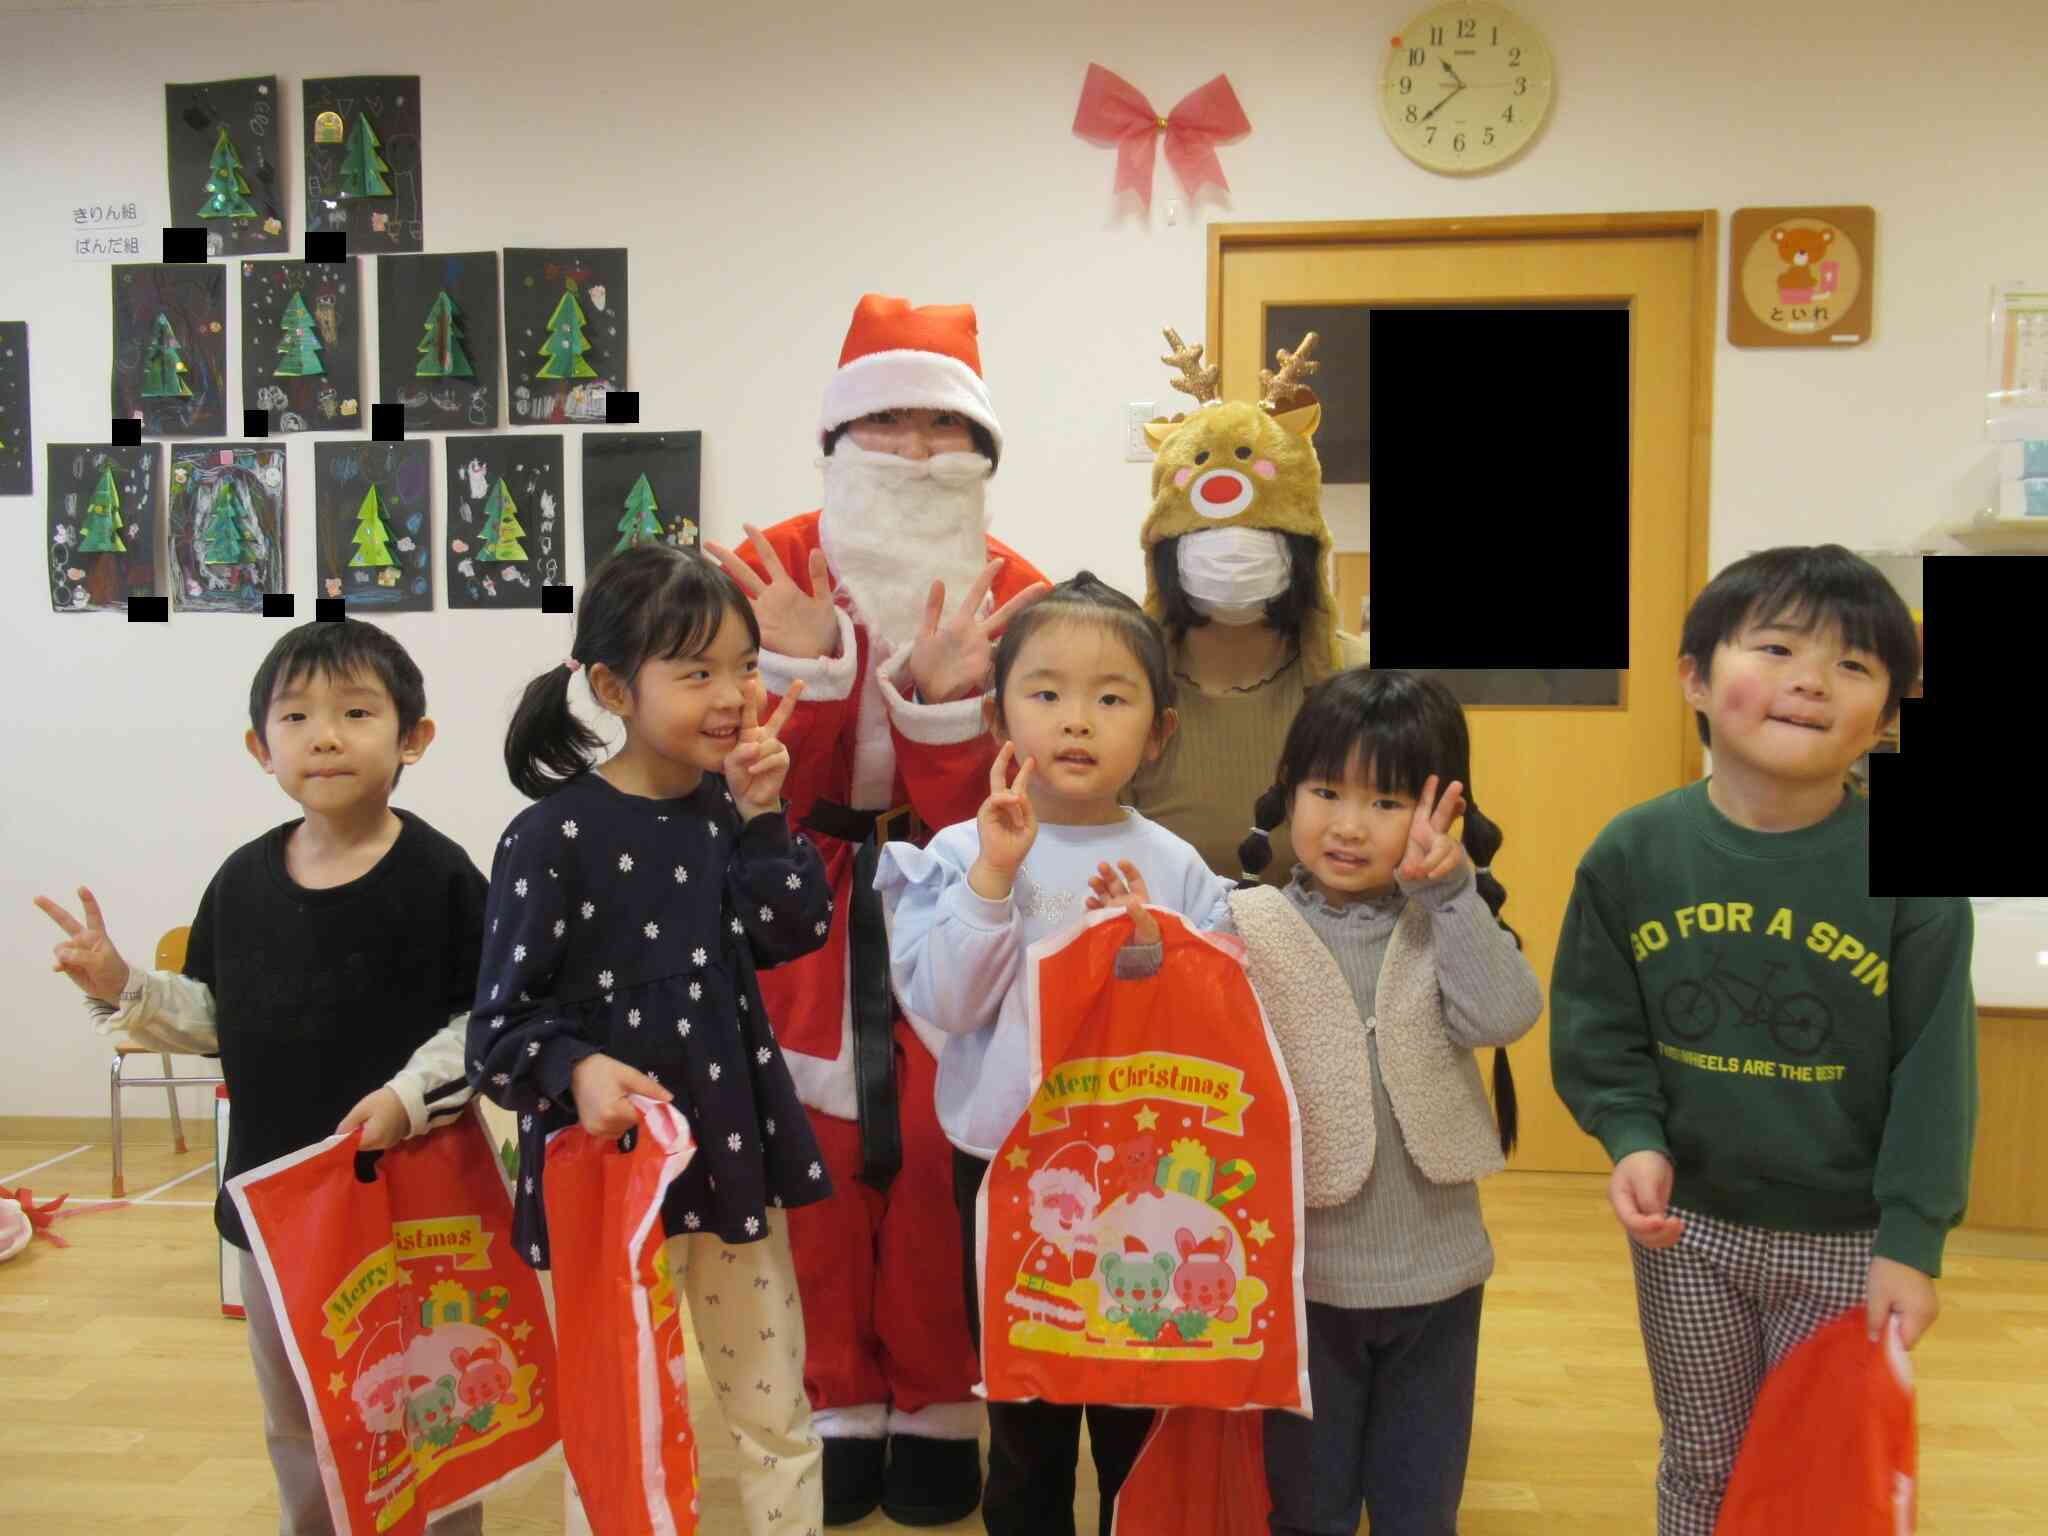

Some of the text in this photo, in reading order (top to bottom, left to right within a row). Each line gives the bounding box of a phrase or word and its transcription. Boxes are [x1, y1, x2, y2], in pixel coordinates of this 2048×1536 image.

[1430, 26, 1444, 47] 11
[1456, 18, 1477, 39] 12
[1491, 25, 1498, 47] 1
[1408, 47, 1426, 67] 10
[1508, 48, 1521, 68] 2
[1400, 76, 1412, 95] 9
[1513, 76, 1527, 96] 3
[1405, 104, 1418, 124] 8
[1502, 104, 1513, 124] 4
[1425, 126, 1437, 145] 7
[1453, 133, 1466, 153] 6
[1483, 127, 1495, 146] 5
[73, 202, 137, 224] きりん組
[1770, 306, 1829, 321] といれ
[1673, 902, 1753, 938] FOR
[1766, 907, 1793, 940] A
[1805, 920, 1888, 998] SPIN
[1743, 1059, 1776, 1077] ARE
[1779, 1063, 1812, 1082] THE
[1815, 1065, 1845, 1082] BEST
[1108, 1064, 1230, 1100] Christmas
[331, 1228, 472, 1318] Merry istmas
